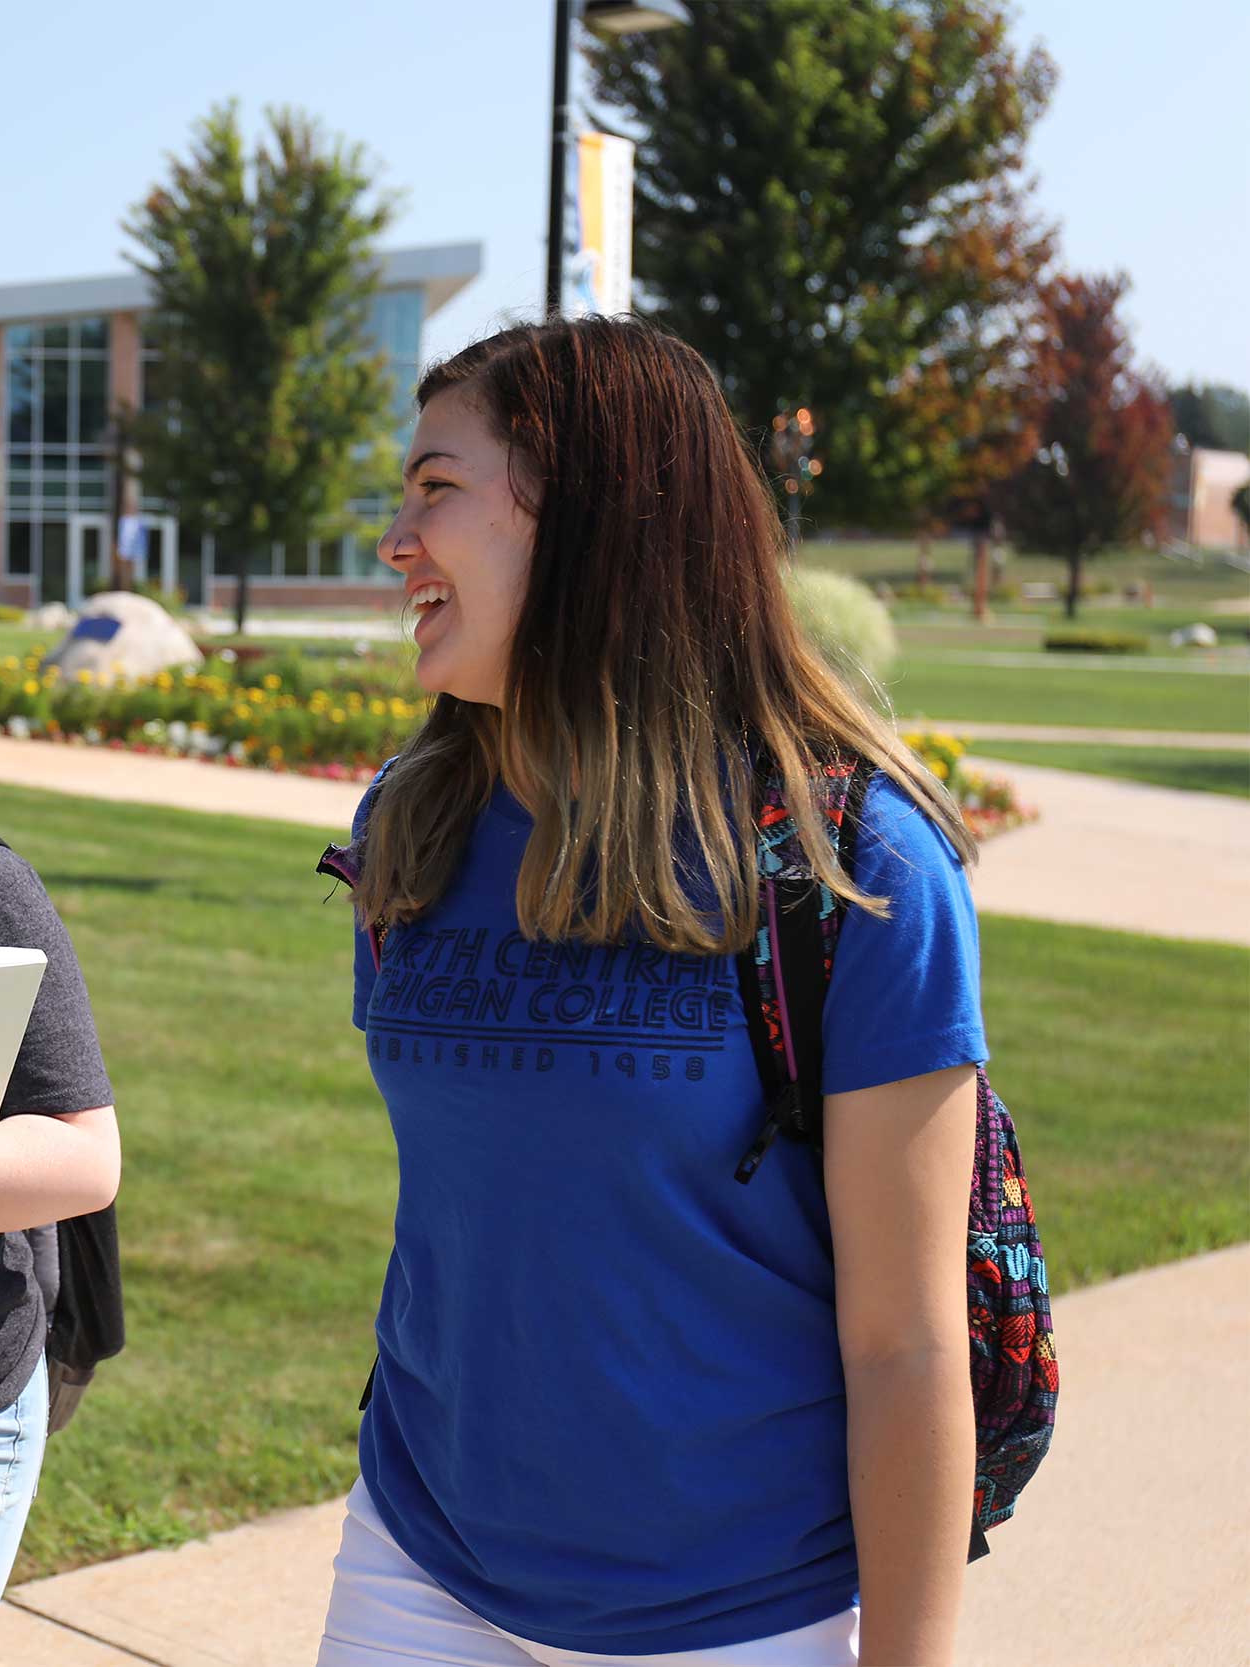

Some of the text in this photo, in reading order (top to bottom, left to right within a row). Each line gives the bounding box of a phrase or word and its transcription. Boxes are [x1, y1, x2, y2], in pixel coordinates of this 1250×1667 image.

[496, 931, 735, 988] CENTRAL
[528, 982, 735, 1031] COLLEGE
[589, 1050, 705, 1082] 1958
